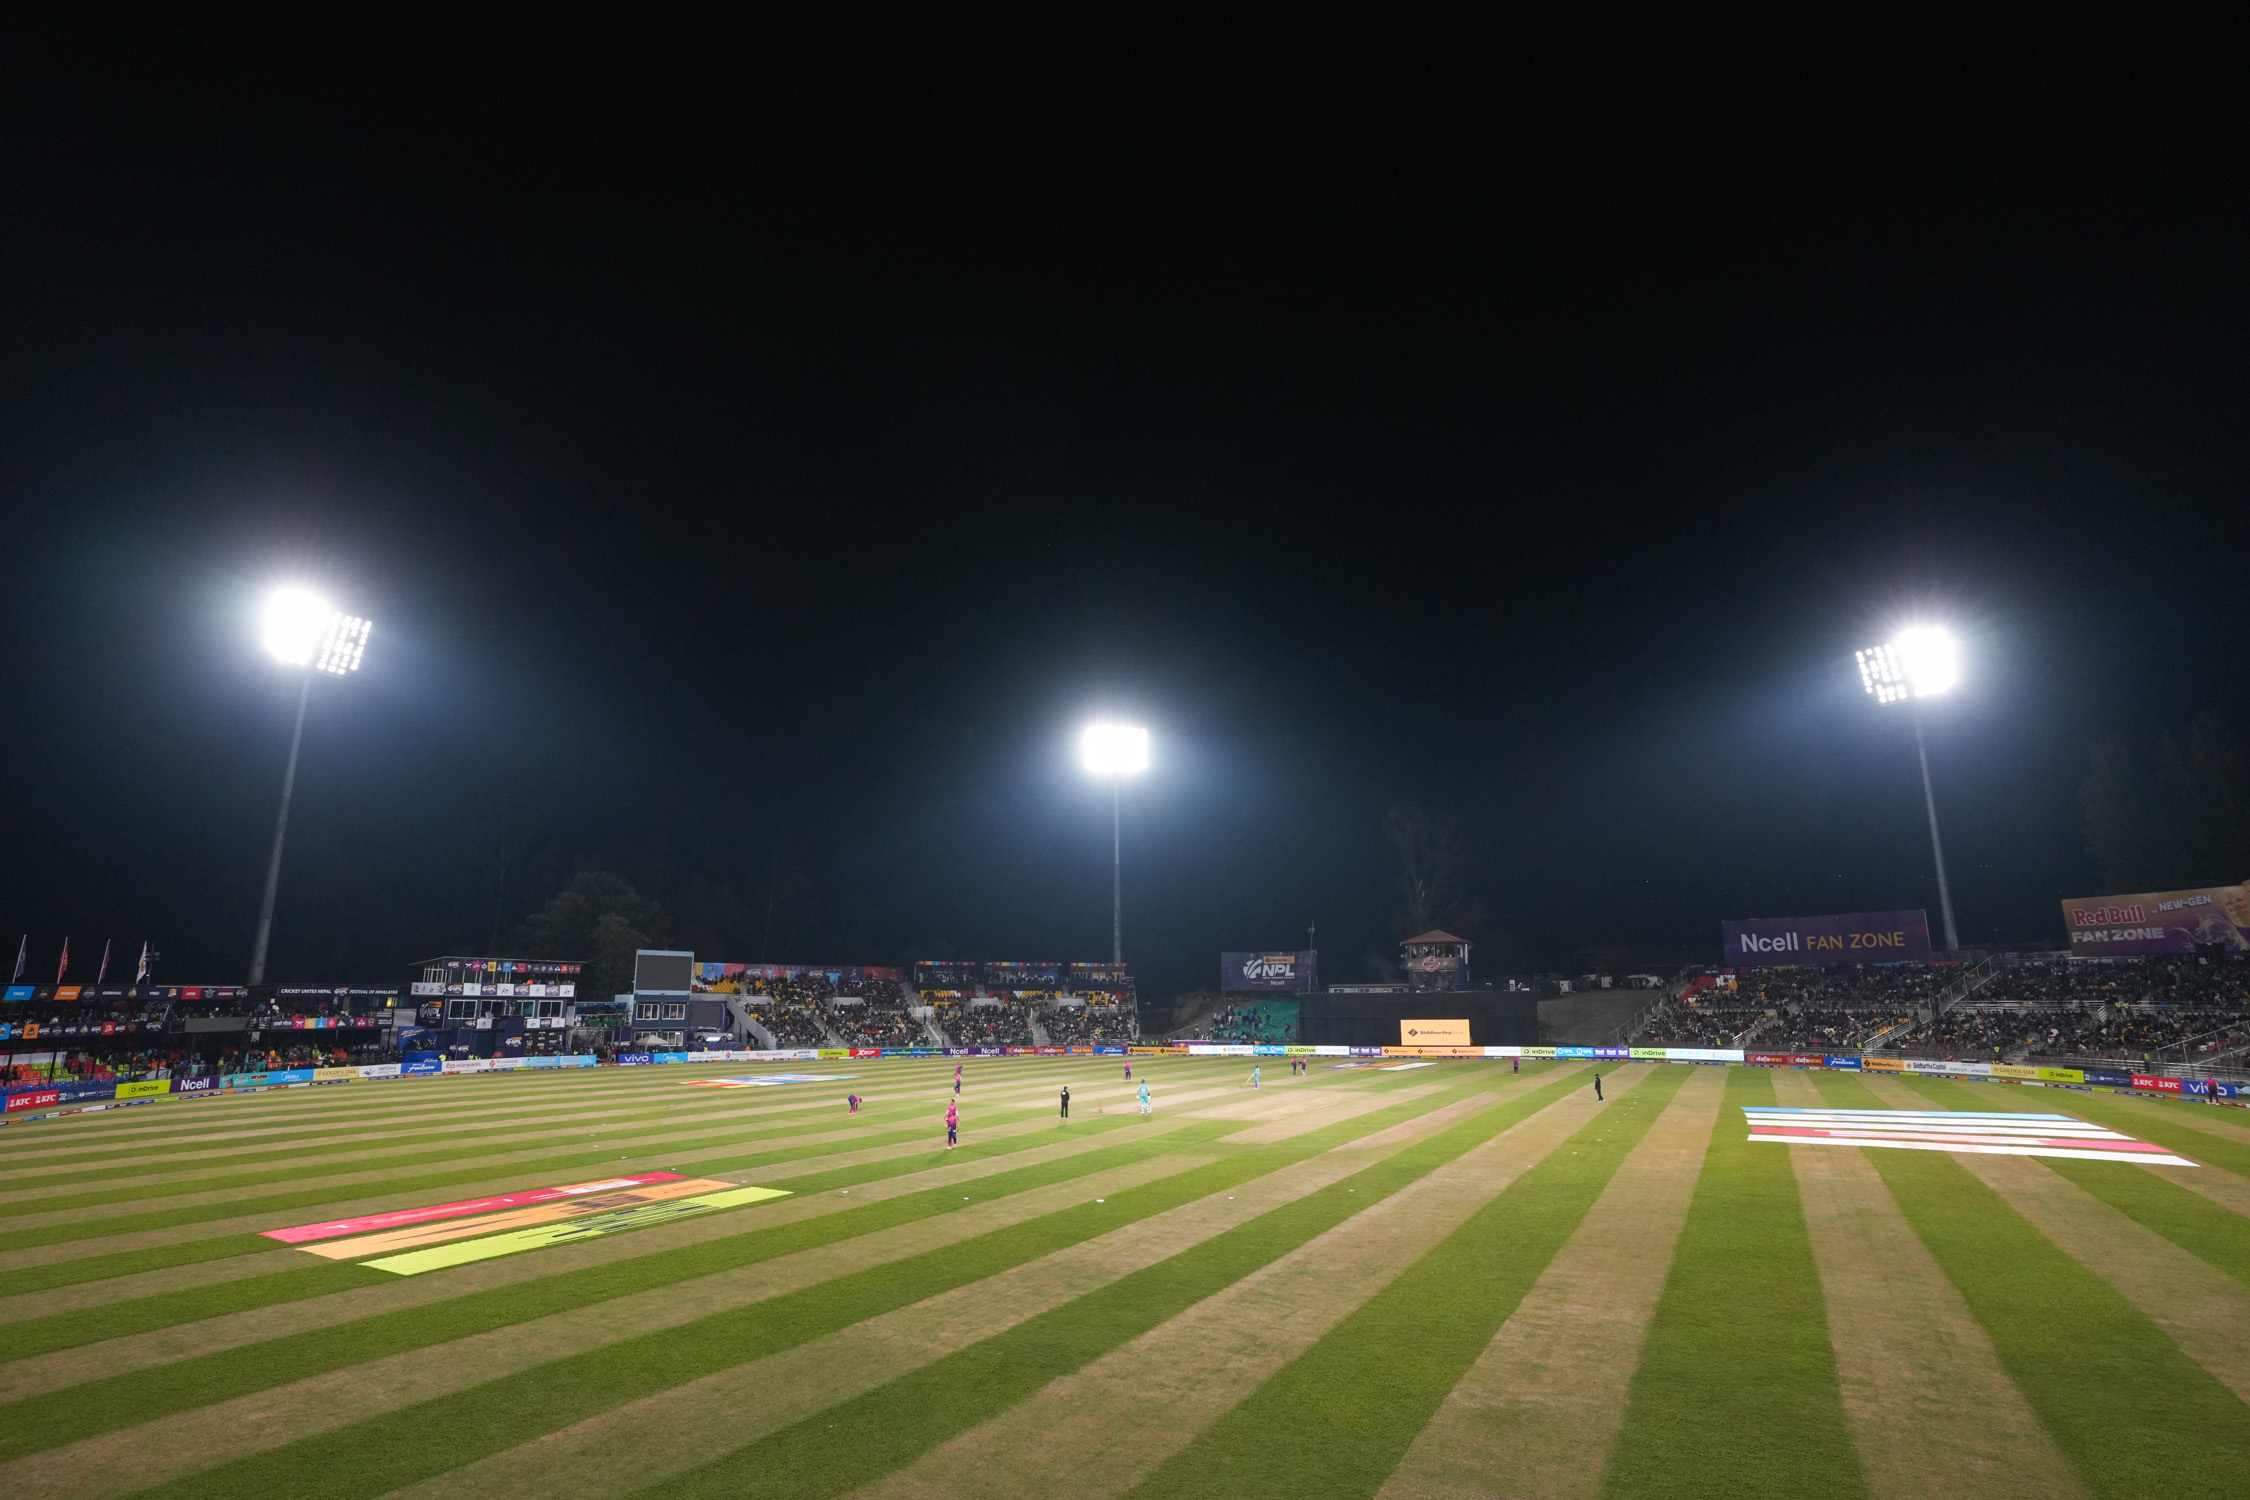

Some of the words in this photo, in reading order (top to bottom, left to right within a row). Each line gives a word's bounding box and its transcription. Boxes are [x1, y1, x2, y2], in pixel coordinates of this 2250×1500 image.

[2158, 895, 2211, 912] NEW-GEN
[2073, 908, 2107, 926] Red
[2108, 905, 2146, 924] Bull
[1740, 932, 1799, 952] Ncell
[1806, 935, 1843, 950] FAN
[1850, 932, 1906, 948] ZONE
[2071, 930, 2110, 943] FAN
[2113, 927, 2165, 941] ZONE
[1262, 964, 1295, 976] NPL
[180, 1078, 210, 1091] Ncell
[16, 1098, 31, 1106] KFC
